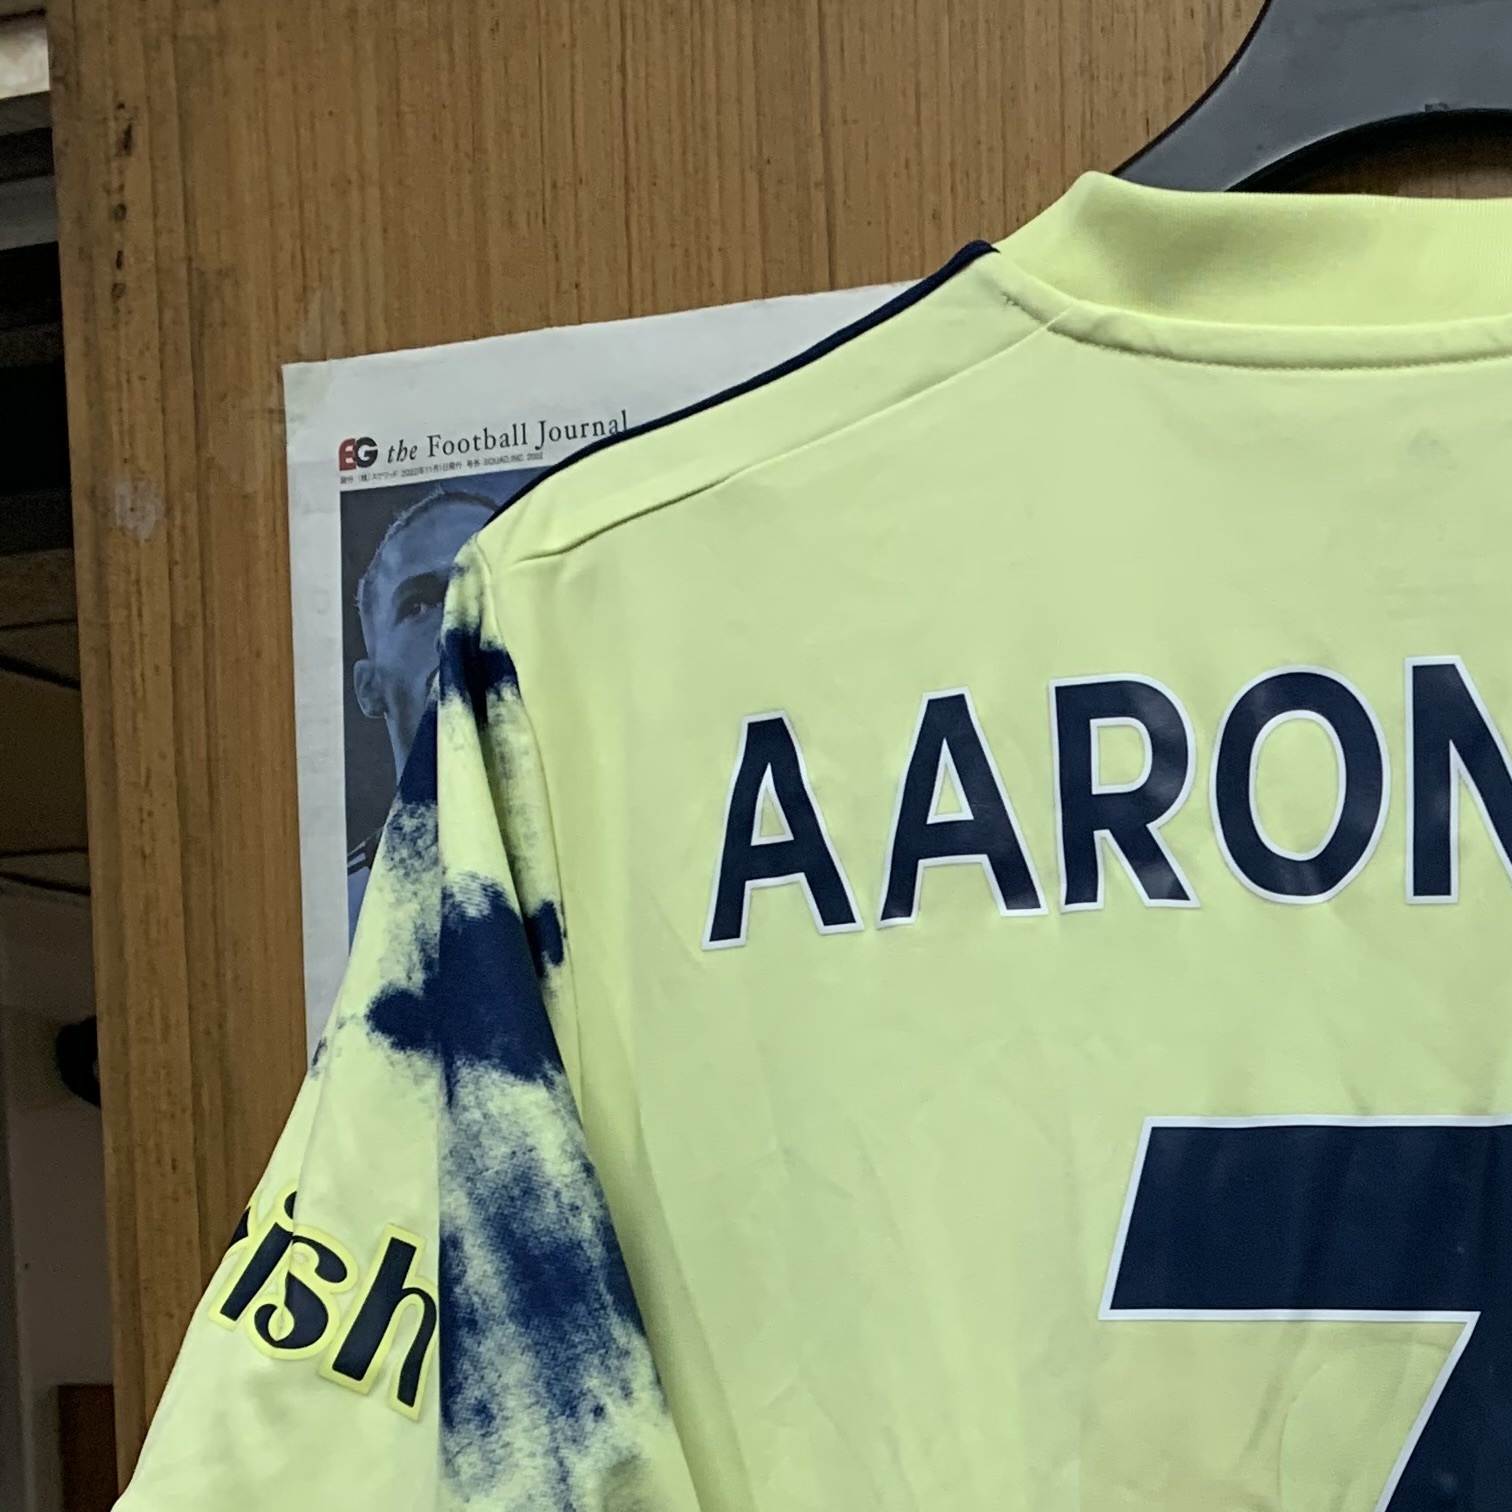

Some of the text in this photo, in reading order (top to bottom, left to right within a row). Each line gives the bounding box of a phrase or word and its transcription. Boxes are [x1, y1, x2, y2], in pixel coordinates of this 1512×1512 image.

[387, 440, 418, 464] the
[427, 421, 527, 458] Football
[536, 408, 628, 450] Journal
[219, 1190, 438, 1408] ish
